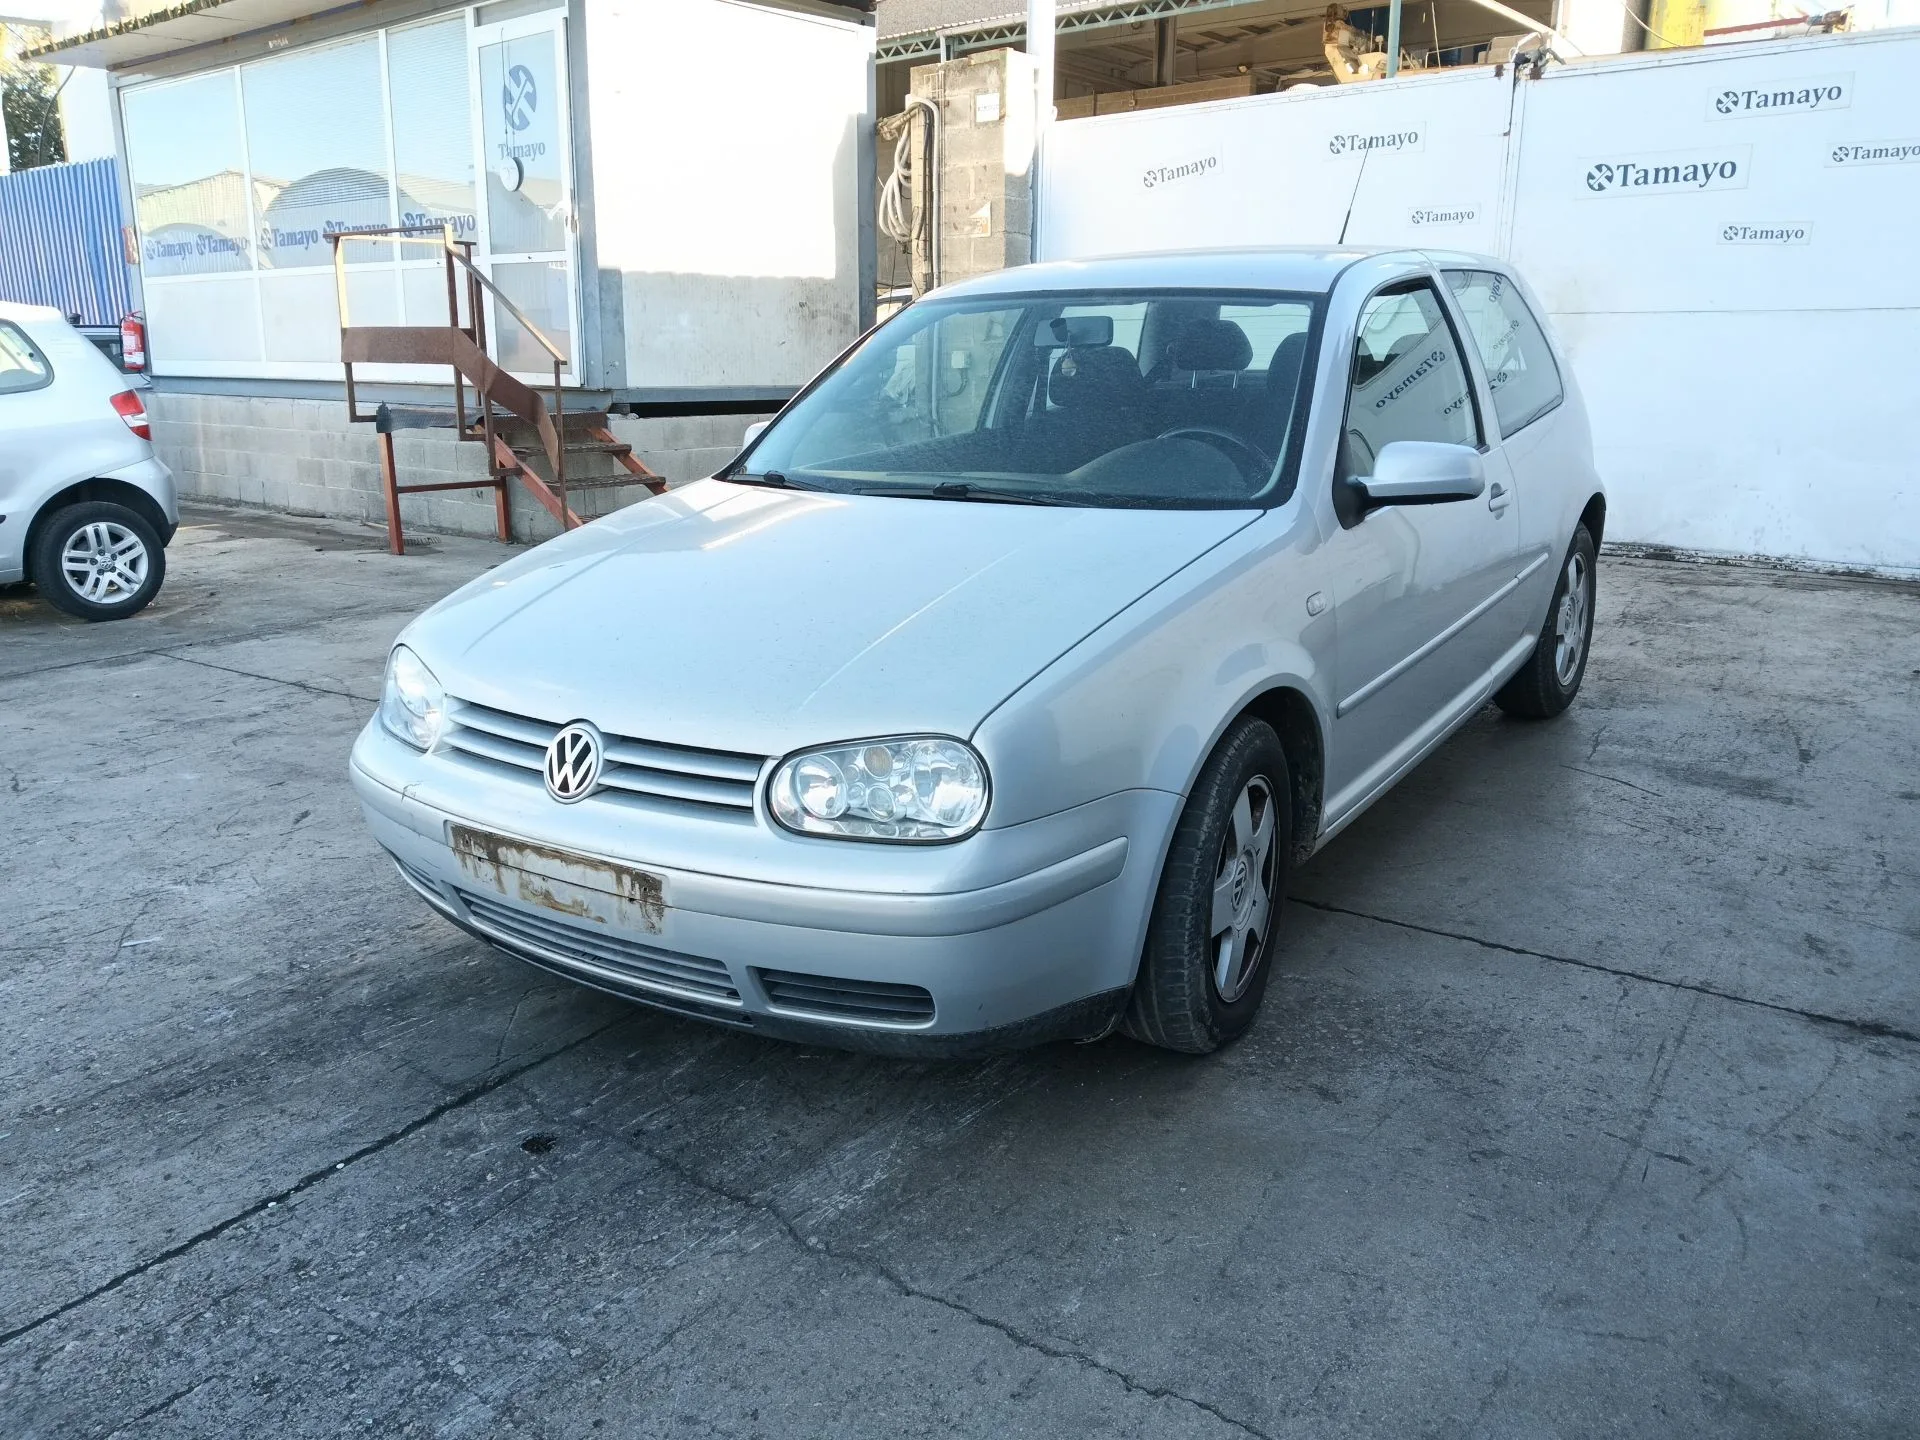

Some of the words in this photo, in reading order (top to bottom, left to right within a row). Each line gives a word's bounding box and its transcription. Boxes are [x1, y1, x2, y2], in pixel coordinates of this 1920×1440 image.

[1742, 85, 1842, 110] Tamayo
[497, 142, 546, 161] Tamayo
[1347, 131, 1419, 151] Tamayo
[1850, 145, 1920, 161] Tamayo
[1157, 156, 1217, 183] Tamayo
[1616, 160, 1737, 188] Tamayo
[415, 213, 476, 238] Tamayo
[1424, 210, 1475, 223] Tamayo
[271, 228, 319, 250] Tamayo
[1740, 226, 1804, 243] Tamayo
[156, 241, 193, 260] Tamayo
[207, 235, 247, 256] Tamayo
[547, 728, 599, 799] VW
